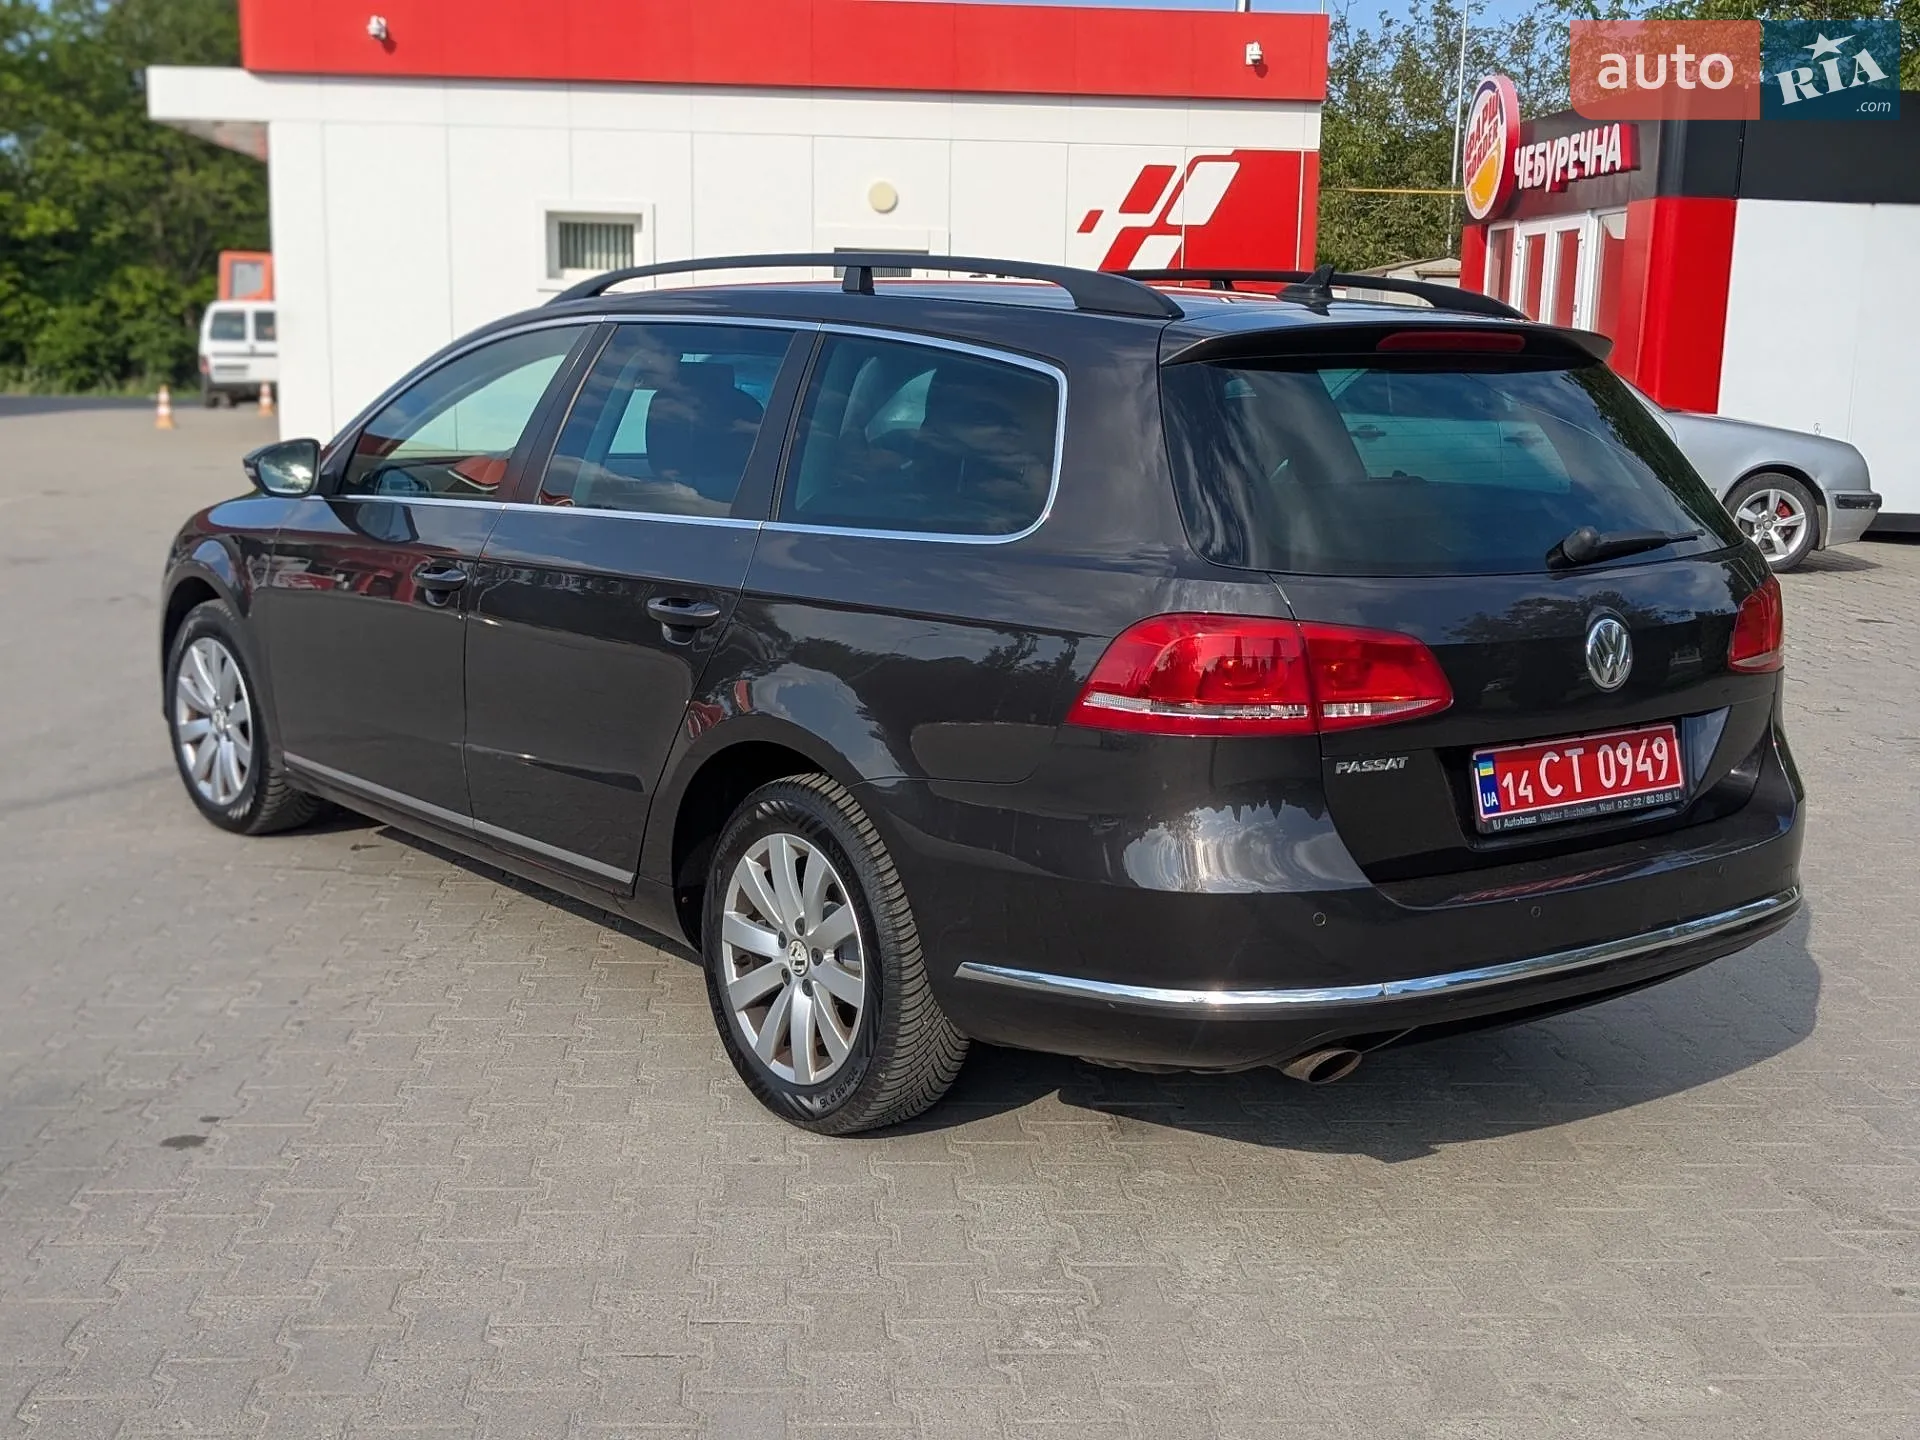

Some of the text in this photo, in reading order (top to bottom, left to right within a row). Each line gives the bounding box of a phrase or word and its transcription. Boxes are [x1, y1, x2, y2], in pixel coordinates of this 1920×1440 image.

[1514, 123, 1621, 193] ЧЕБУРЕЧНА
[1335, 757, 1409, 774] PASSAT
[1502, 737, 1669, 806] 14 CT 0949
[1483, 791, 1498, 808] UA
[1504, 814, 1537, 828] Autohaus
